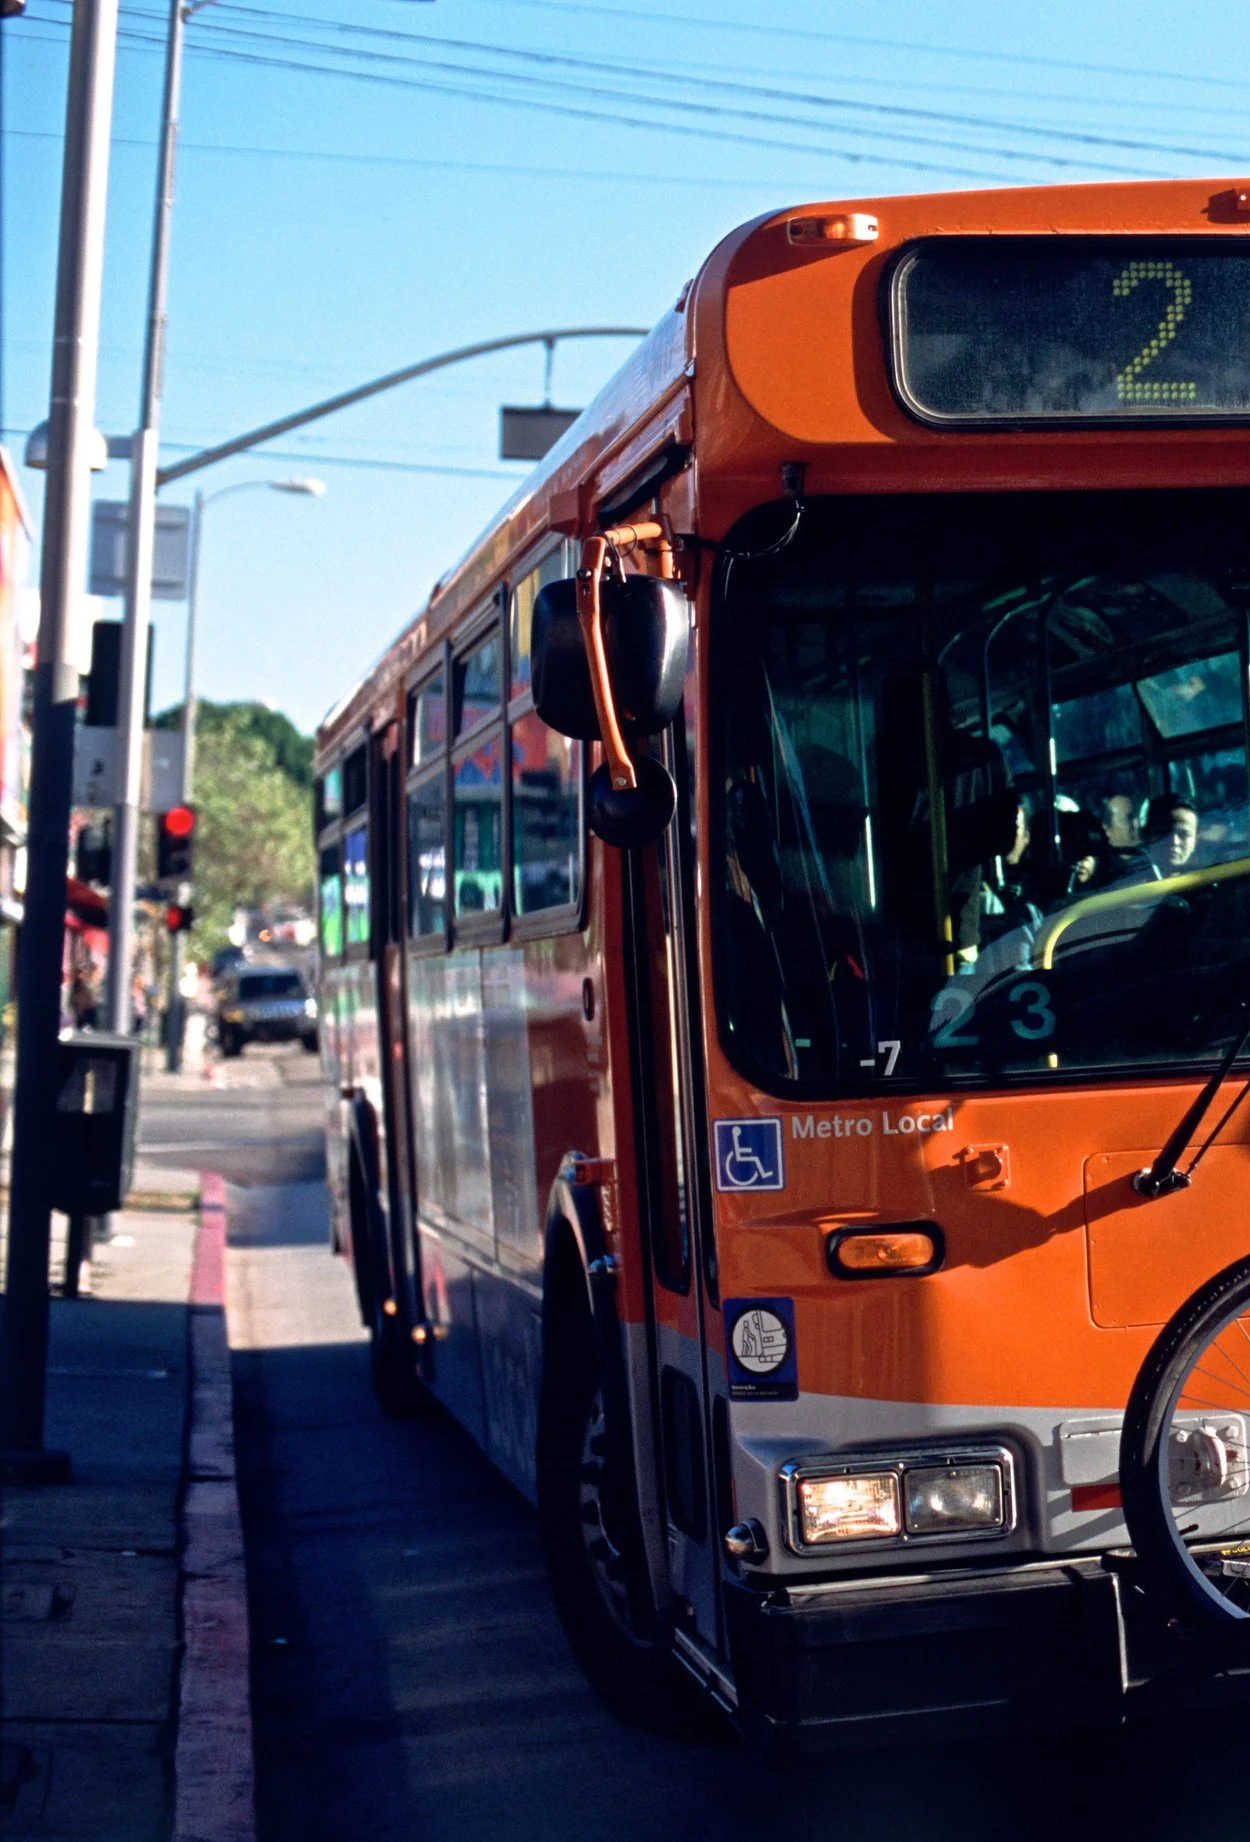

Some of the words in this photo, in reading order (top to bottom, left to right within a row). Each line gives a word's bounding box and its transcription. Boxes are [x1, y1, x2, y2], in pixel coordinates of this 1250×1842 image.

[1112, 262, 1196, 400] 2
[792, 1115, 873, 1140] Metro
[883, 1108, 954, 1134] Local
